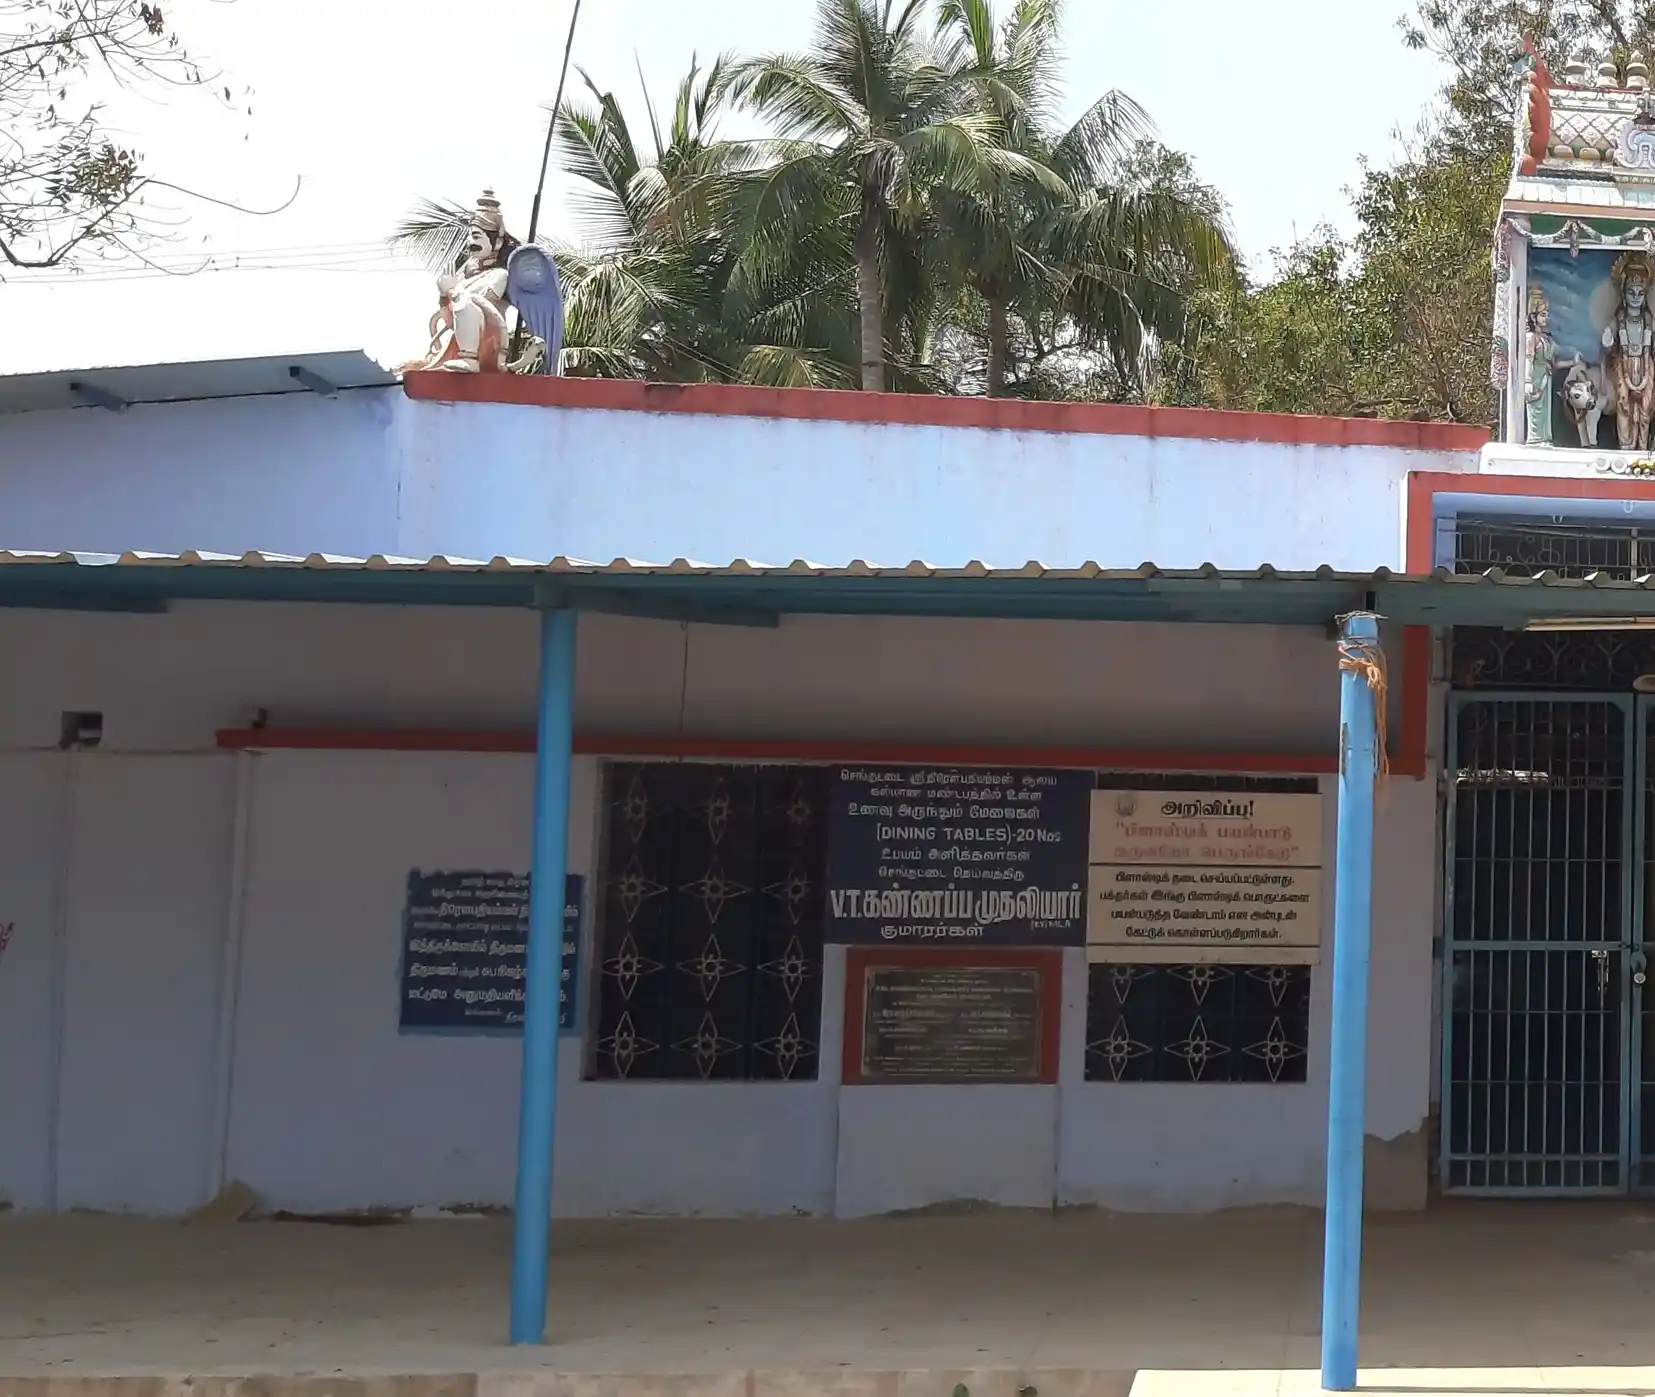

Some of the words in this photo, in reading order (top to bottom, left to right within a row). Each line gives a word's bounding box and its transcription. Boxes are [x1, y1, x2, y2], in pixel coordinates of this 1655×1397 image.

[848, 803, 893, 818] உணவு
[970, 804, 1041, 820] மேஜைகள்
[1161, 799, 1255, 820] அறிவிப்பு!
[877, 823, 937, 842] (DINING
[882, 847, 922, 860] உபயம்
[880, 922, 985, 939] குமாரர்கள்
